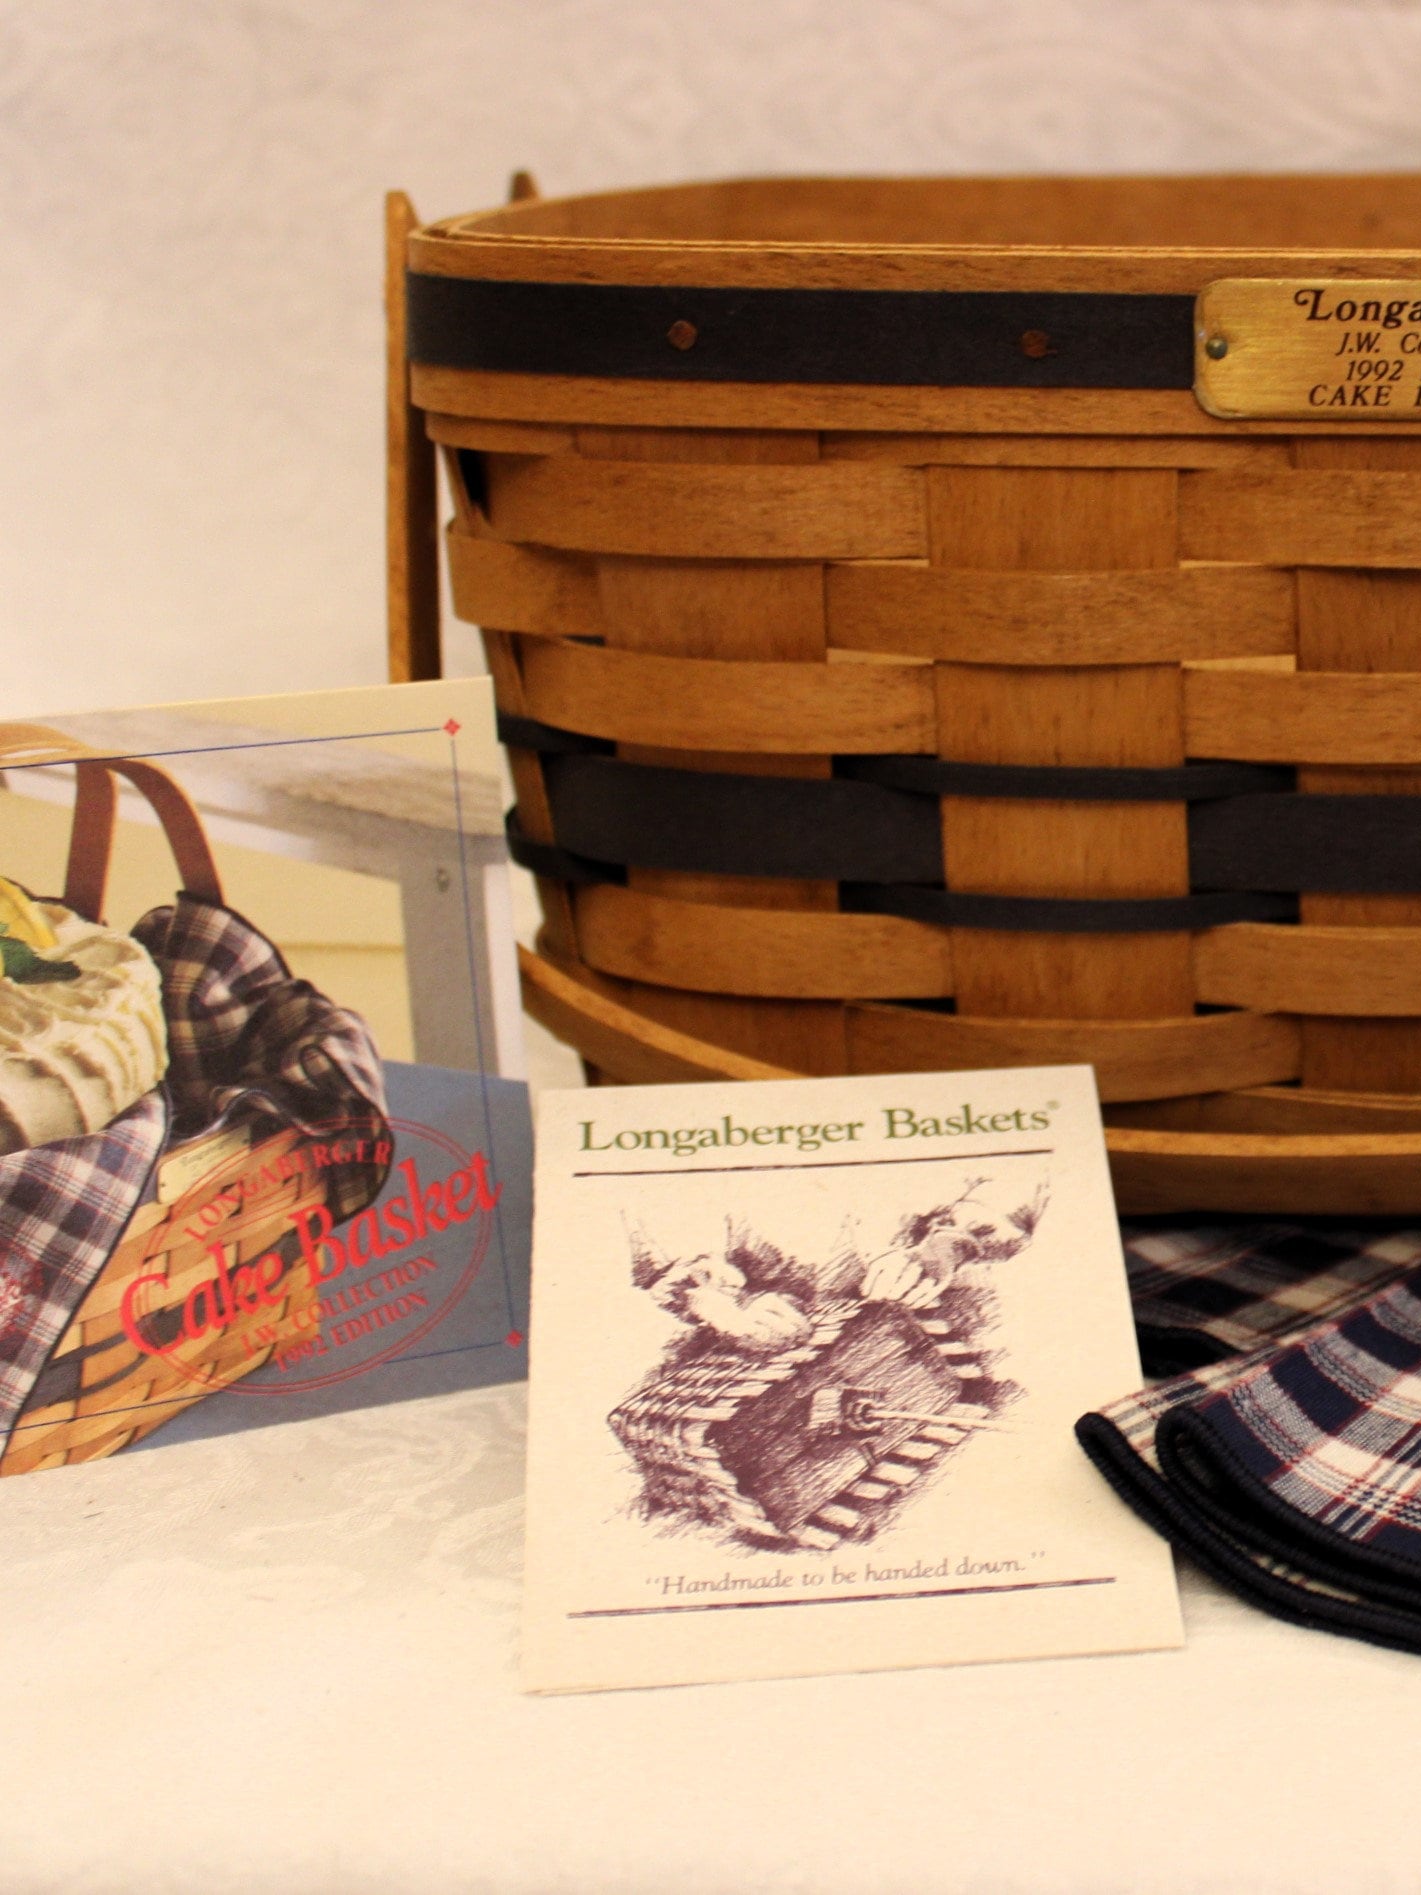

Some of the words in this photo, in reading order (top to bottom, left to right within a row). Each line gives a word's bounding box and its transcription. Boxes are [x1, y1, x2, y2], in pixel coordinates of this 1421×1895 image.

[1335, 332, 1380, 356] J.W.
[1346, 360, 1404, 381] 1992
[1309, 384, 1392, 406] CAKE
[578, 1114, 865, 1156] Longaberger
[184, 1139, 391, 1242] LONGABERGER
[119, 1240, 295, 1356] Cake
[287, 1150, 504, 1288] Basket
[291, 1252, 438, 1330] COLLECTION
[329, 1289, 429, 1347] EDITION
[802, 1571, 824, 1587] to
[831, 1565, 857, 1585] be
[865, 1558, 950, 1583] handed
